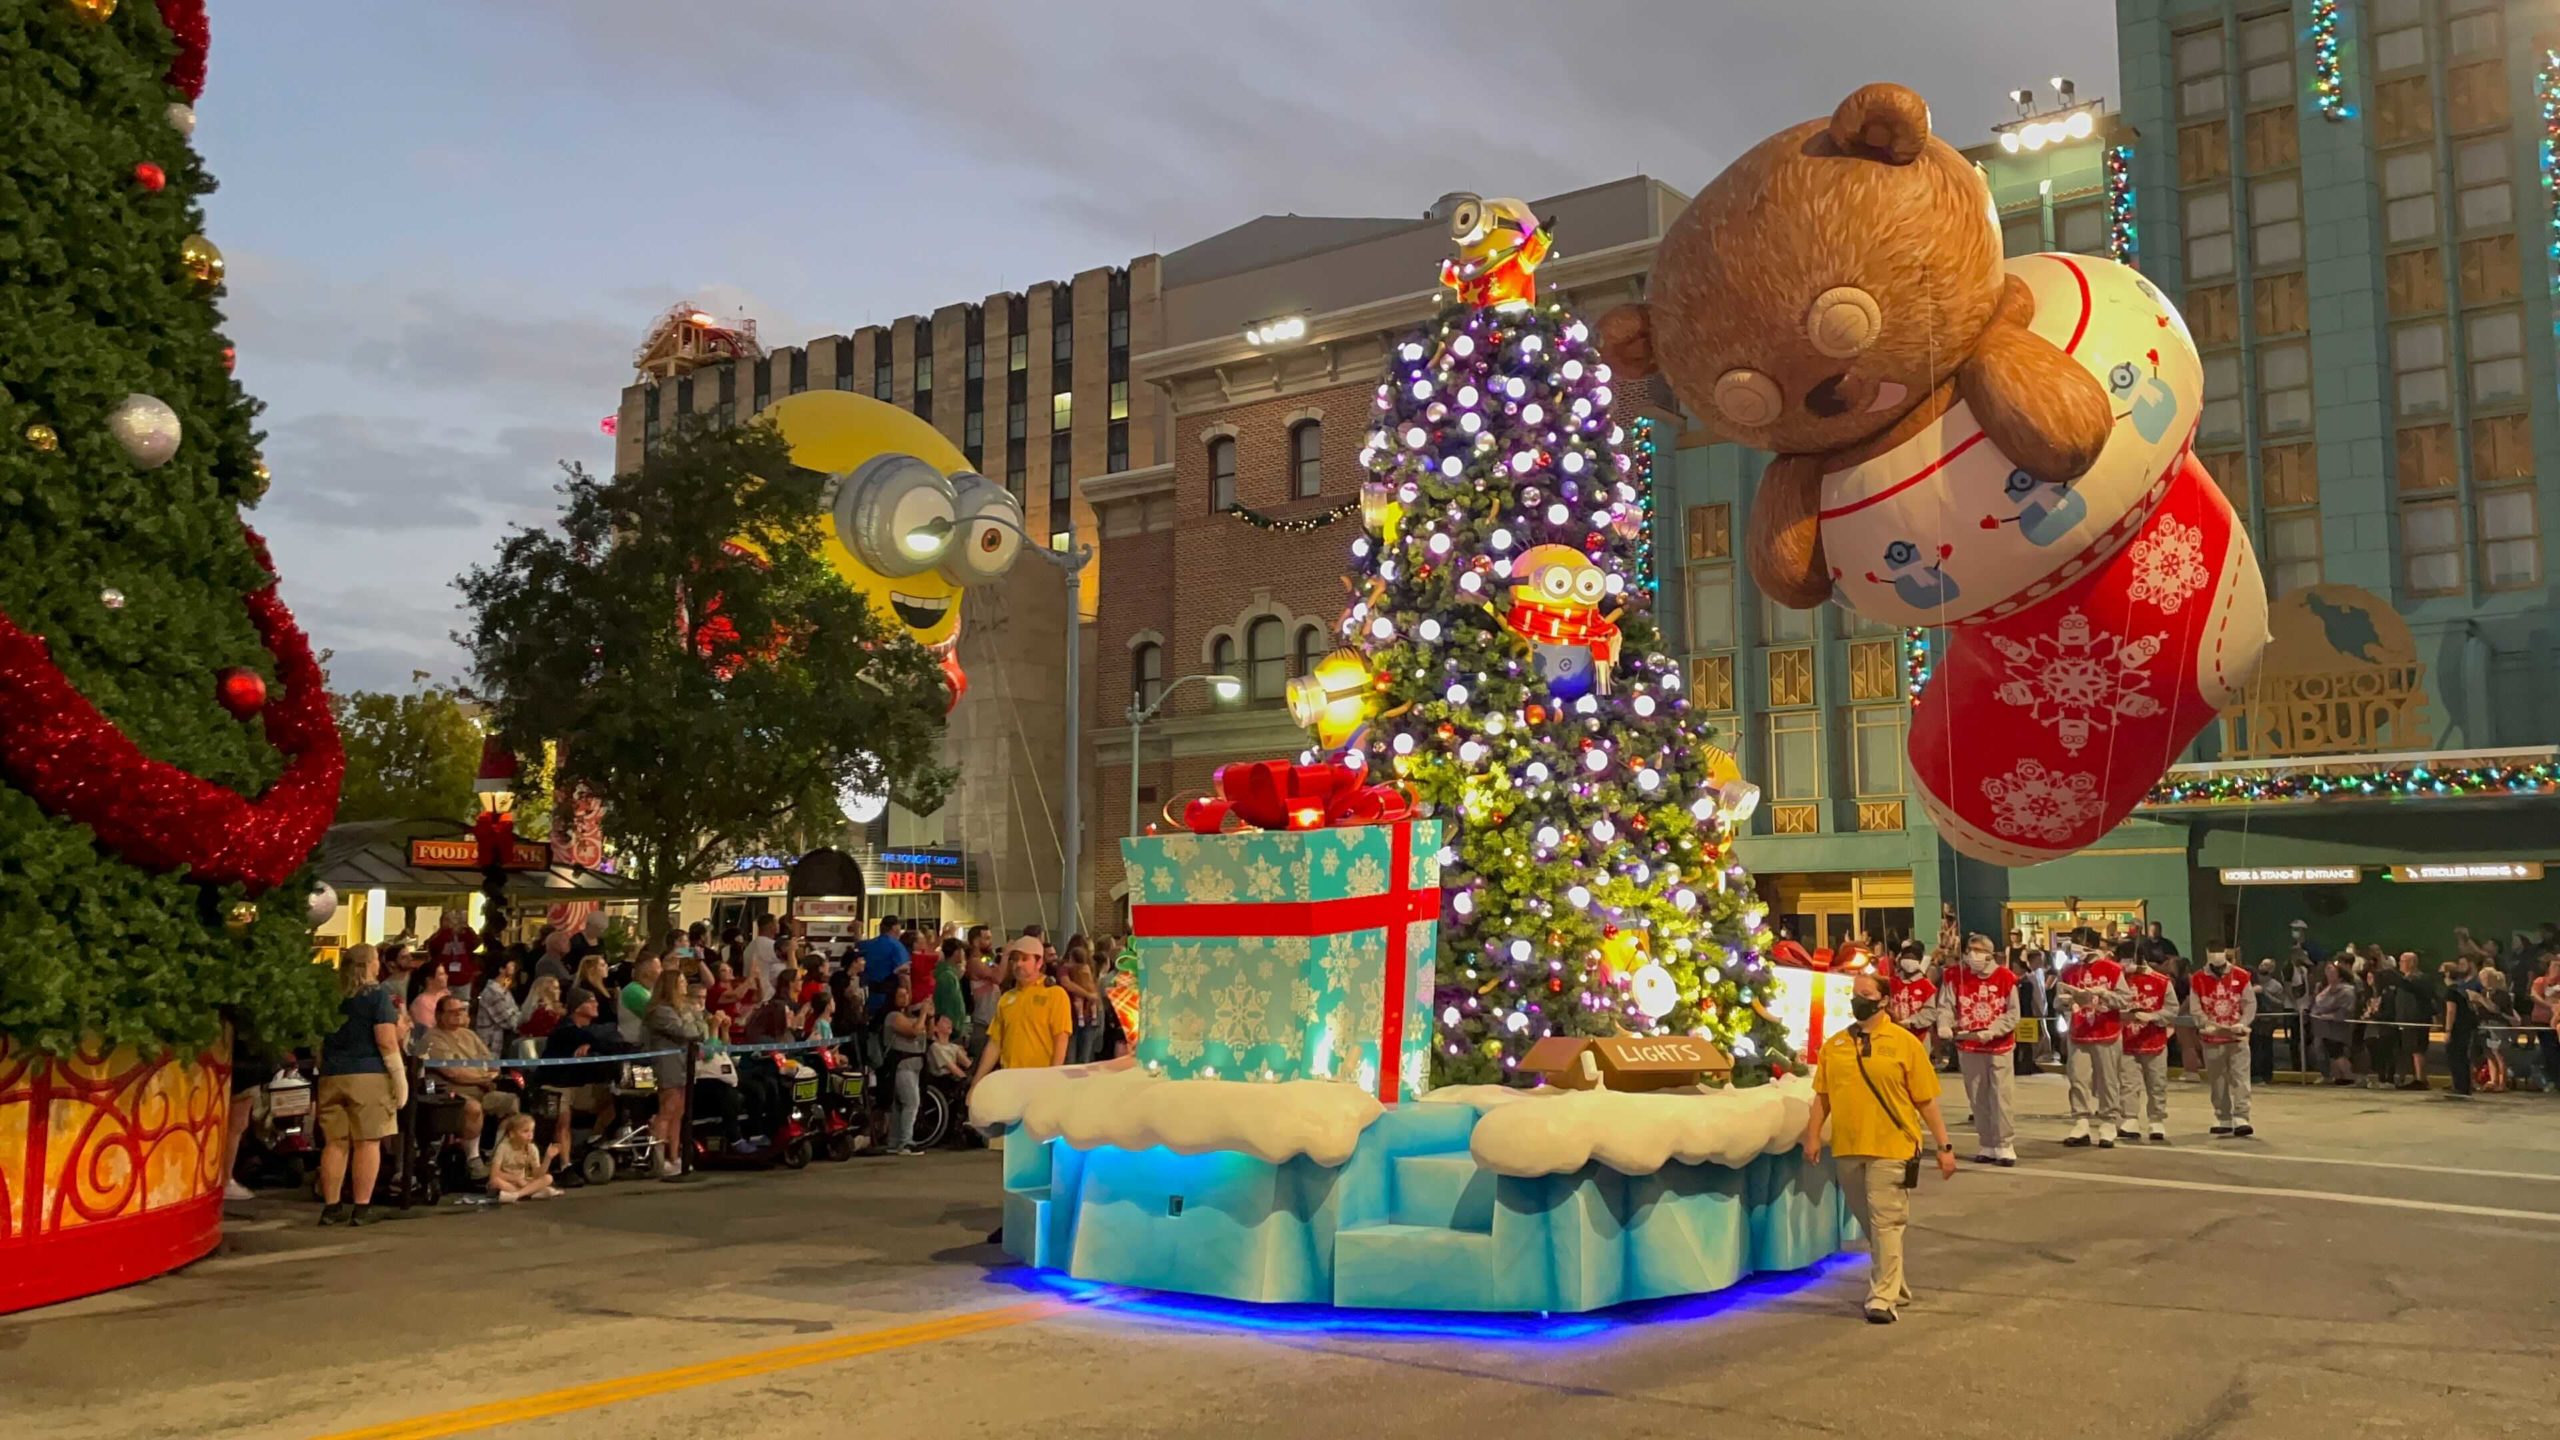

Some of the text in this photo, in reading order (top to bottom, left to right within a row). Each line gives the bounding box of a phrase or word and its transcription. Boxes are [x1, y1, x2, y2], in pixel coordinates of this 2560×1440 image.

[2219, 696, 2434, 755] TRIBUNE
[418, 845, 469, 860] FOOD
[897, 853, 932, 865] TONIGHT
[933, 856, 959, 865] SHOW
[2305, 869, 2354, 880] ENTRANCE
[2420, 866, 2468, 877] STROLLER
[701, 876, 757, 893] STARRING
[887, 872, 932, 890] NBC
[1616, 1043, 1701, 1063] LIGHTS
